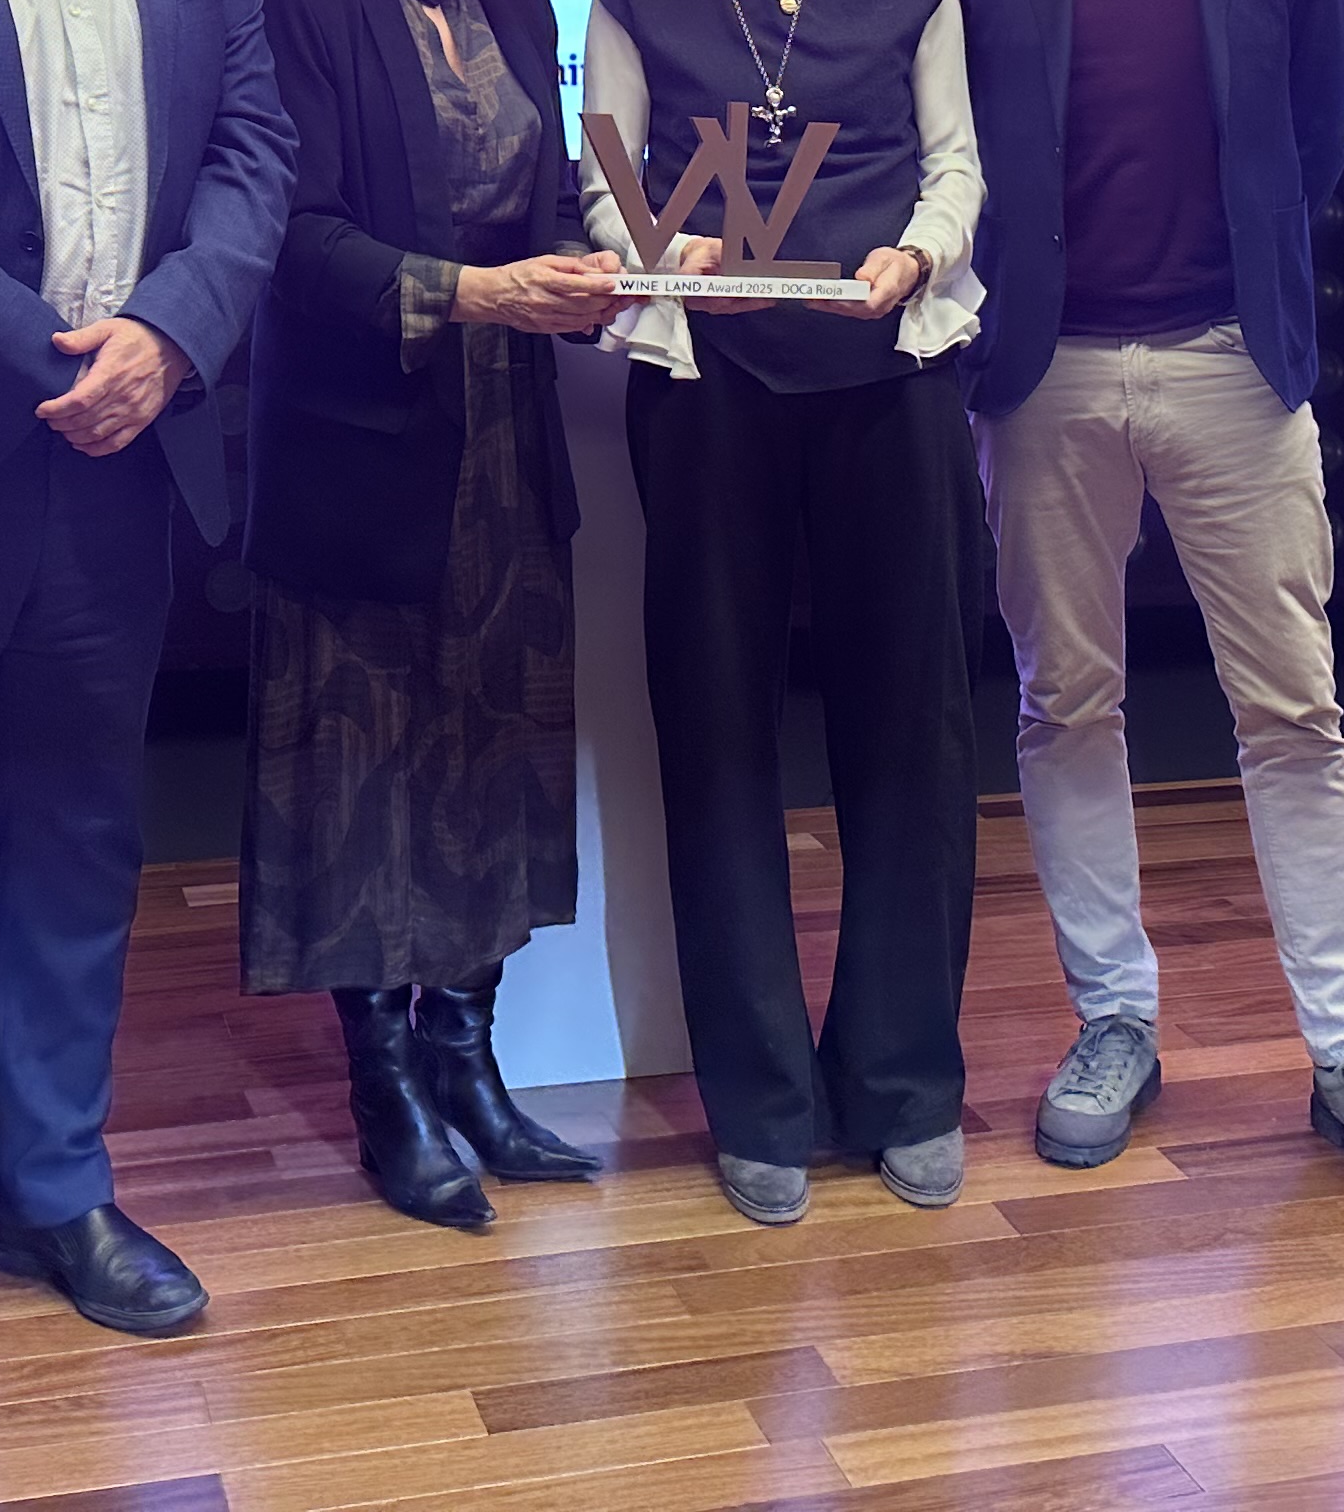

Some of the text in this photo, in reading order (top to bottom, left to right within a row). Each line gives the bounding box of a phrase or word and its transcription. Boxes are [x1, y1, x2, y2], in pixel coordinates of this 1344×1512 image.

[620, 279, 843, 297] WINE LAND Award 2025 DOCa Rioja
